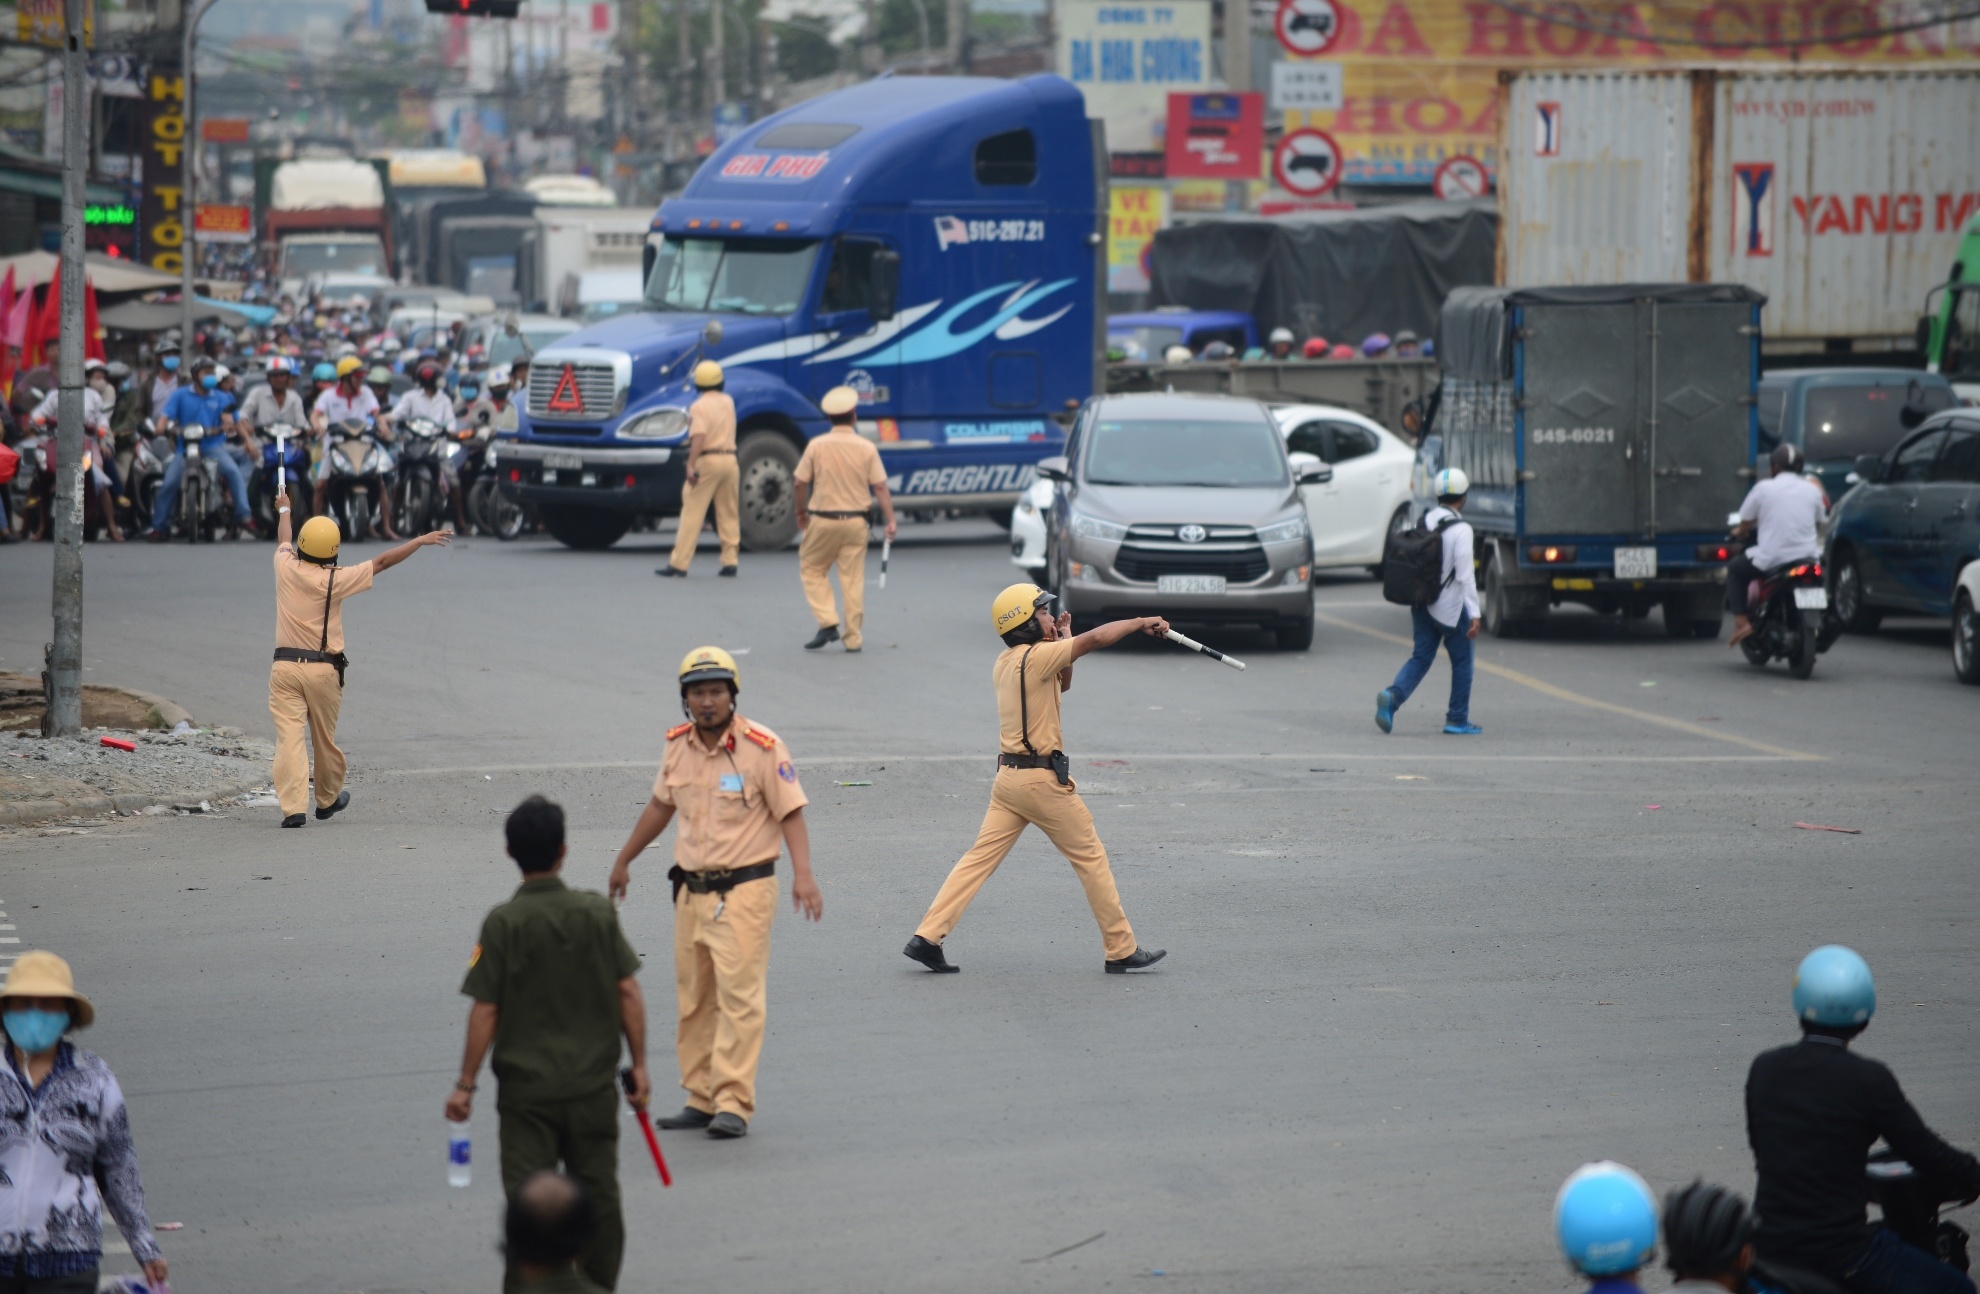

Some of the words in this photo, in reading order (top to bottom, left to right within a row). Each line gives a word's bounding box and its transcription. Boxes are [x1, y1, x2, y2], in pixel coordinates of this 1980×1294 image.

[1101, 39, 1134, 82] HOA
[722, 154, 770, 177] GIA
[1791, 193, 1923, 236] YANG
[968, 219, 1044, 242] 51C-297.21
[945, 421, 1046, 438] COLUMBIA
[1533, 428, 1615, 444] 54S-6021
[1620, 564, 1650, 577] 6021
[997, 606, 1022, 626] CSGT
